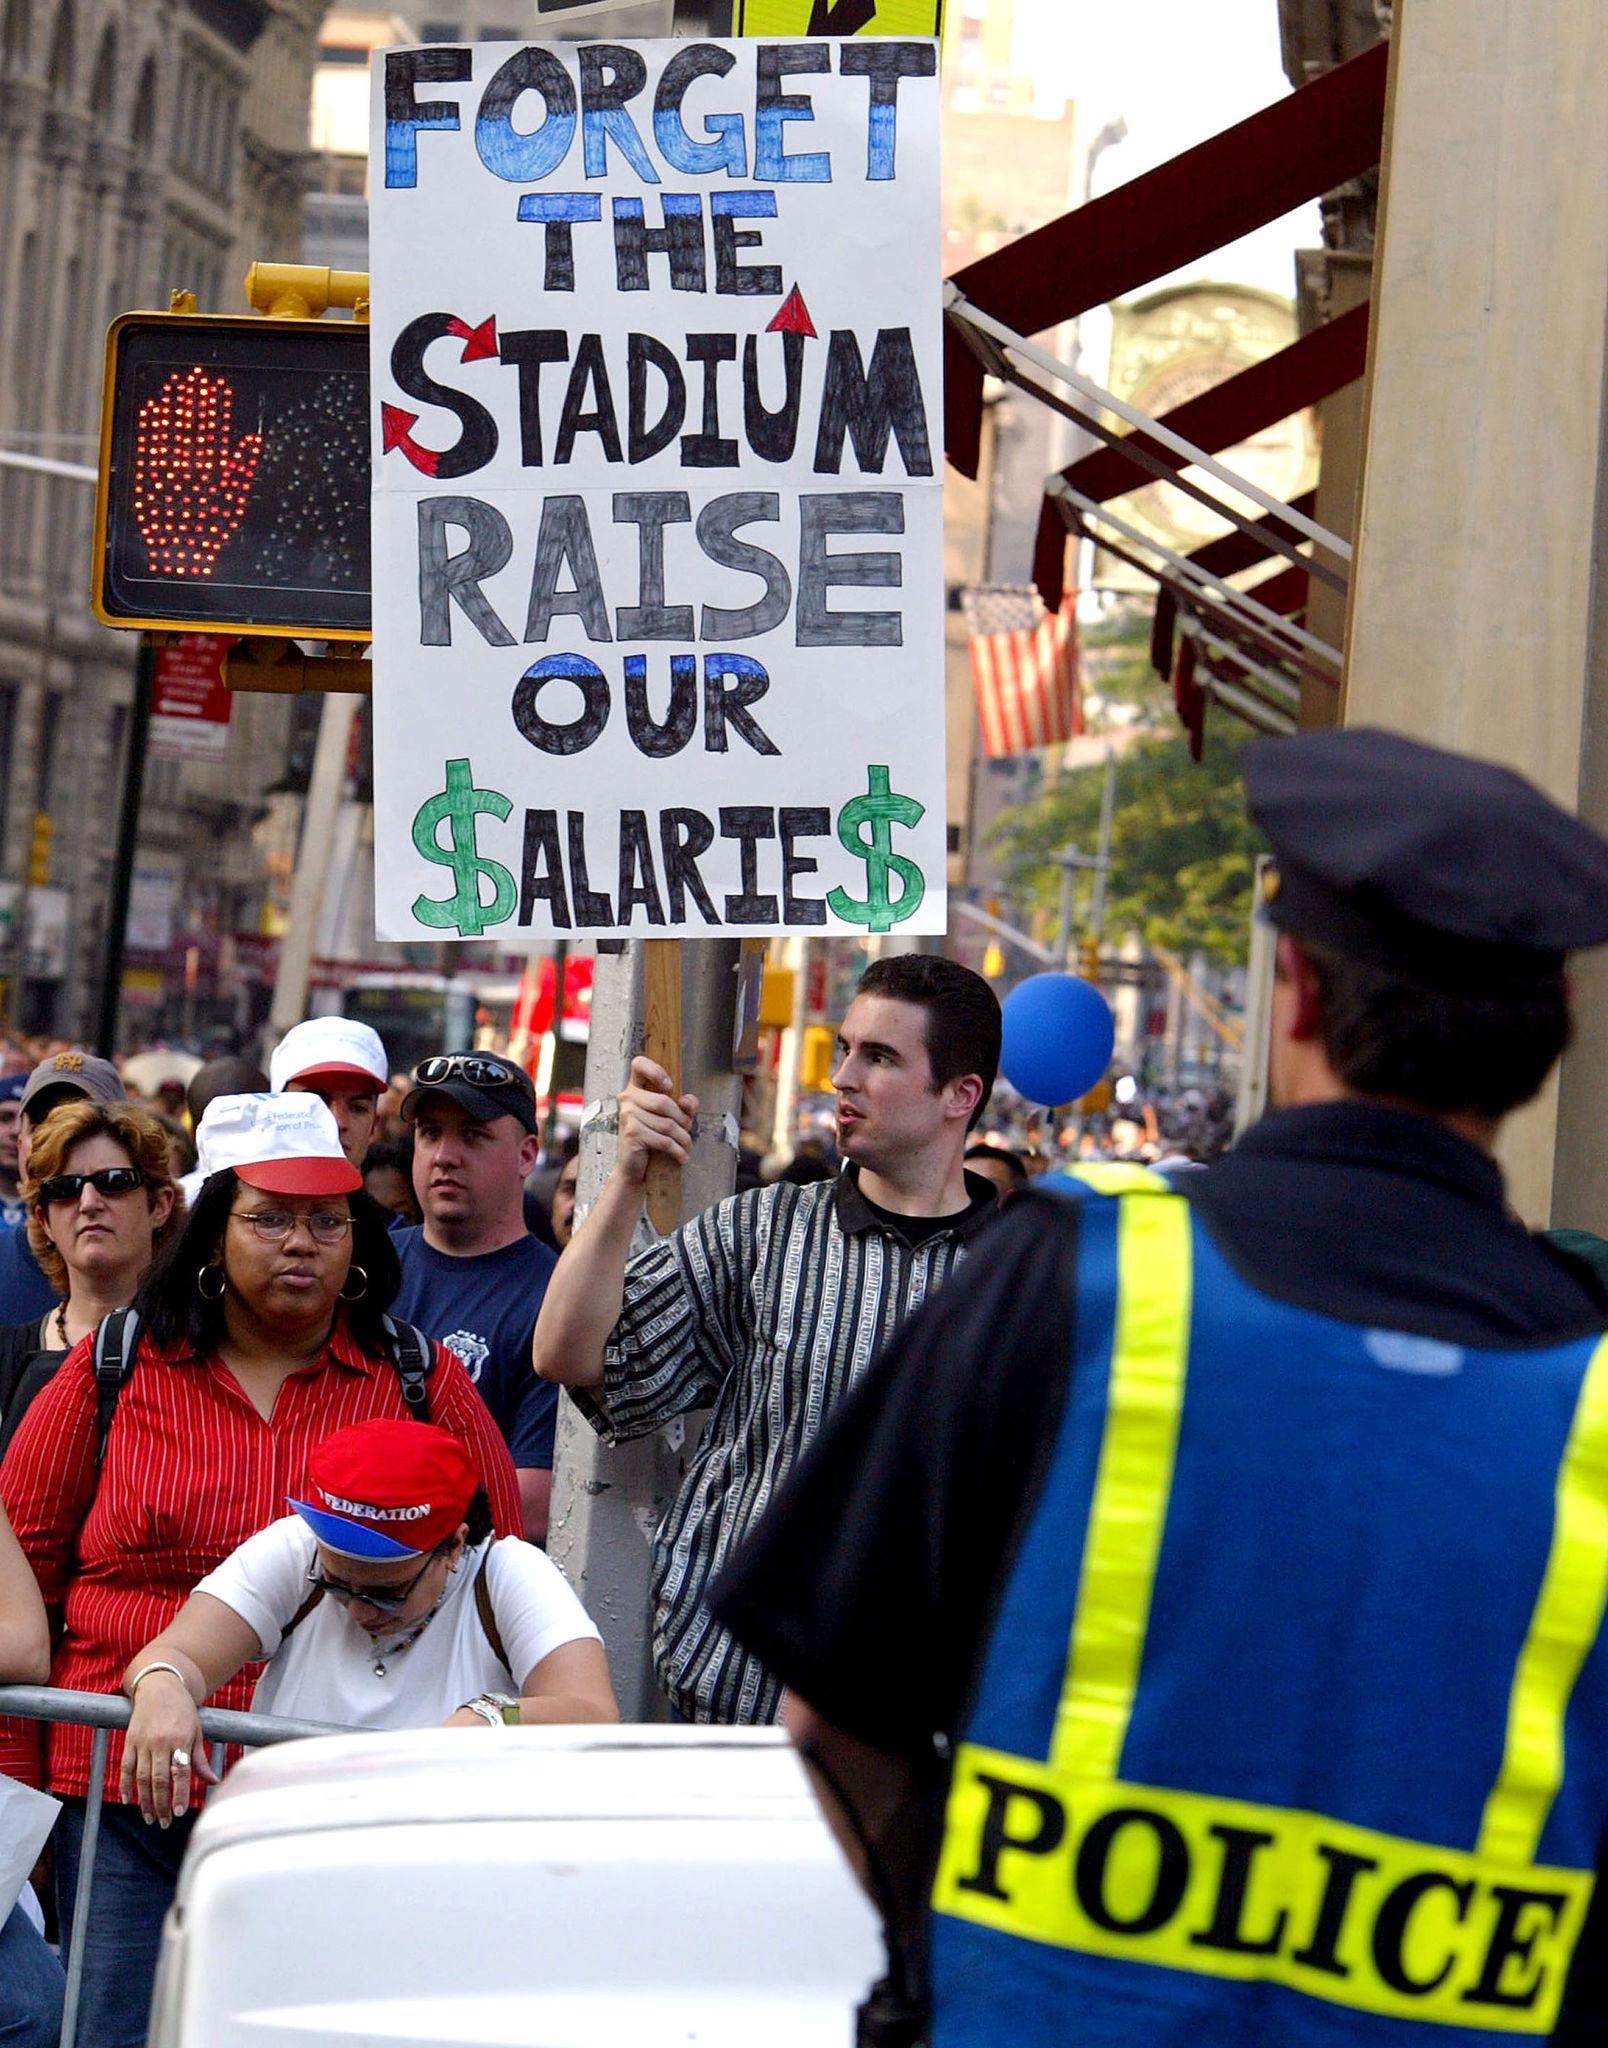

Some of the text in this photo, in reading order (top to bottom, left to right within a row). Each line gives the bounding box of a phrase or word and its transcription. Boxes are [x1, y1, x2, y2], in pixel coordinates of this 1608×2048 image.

[385, 42, 937, 190] FORGET
[517, 190, 783, 295] THE
[381, 283, 934, 480] STADIUM
[417, 491, 905, 647] RAISE
[511, 652, 782, 758] OUR
[412, 758, 925, 936] $ALARIE$
[324, 1490, 431, 1521] FEDERATION
[955, 1772, 1568, 2010] POLICE
